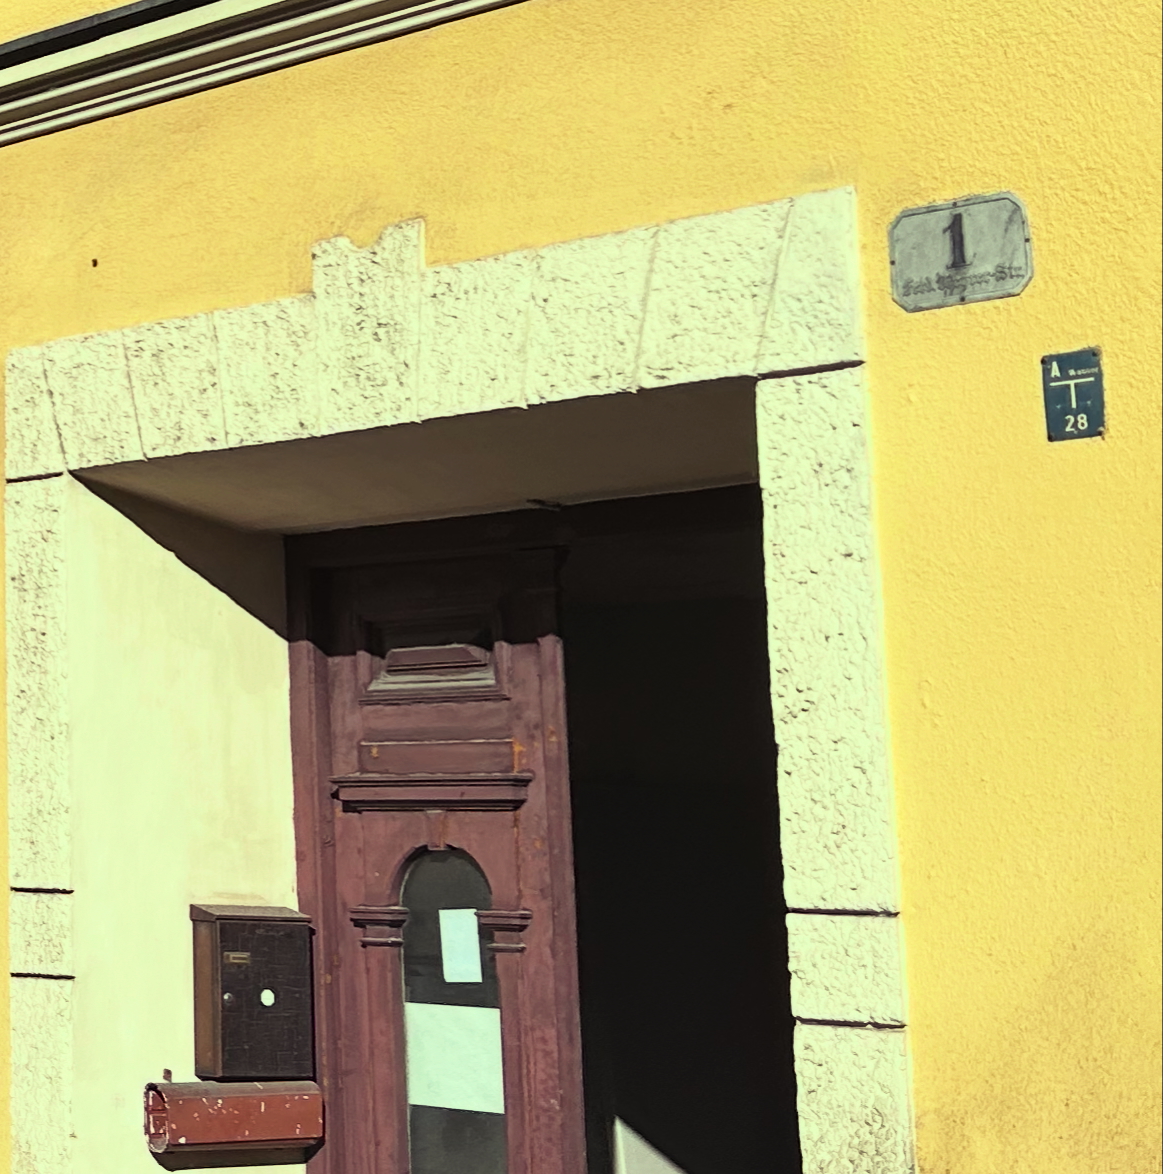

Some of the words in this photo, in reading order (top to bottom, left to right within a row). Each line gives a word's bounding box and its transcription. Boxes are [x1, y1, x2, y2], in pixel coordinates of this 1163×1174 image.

[942, 212, 972, 270] 1
[1050, 360, 1061, 378] A
[1064, 413, 1089, 433] 28
